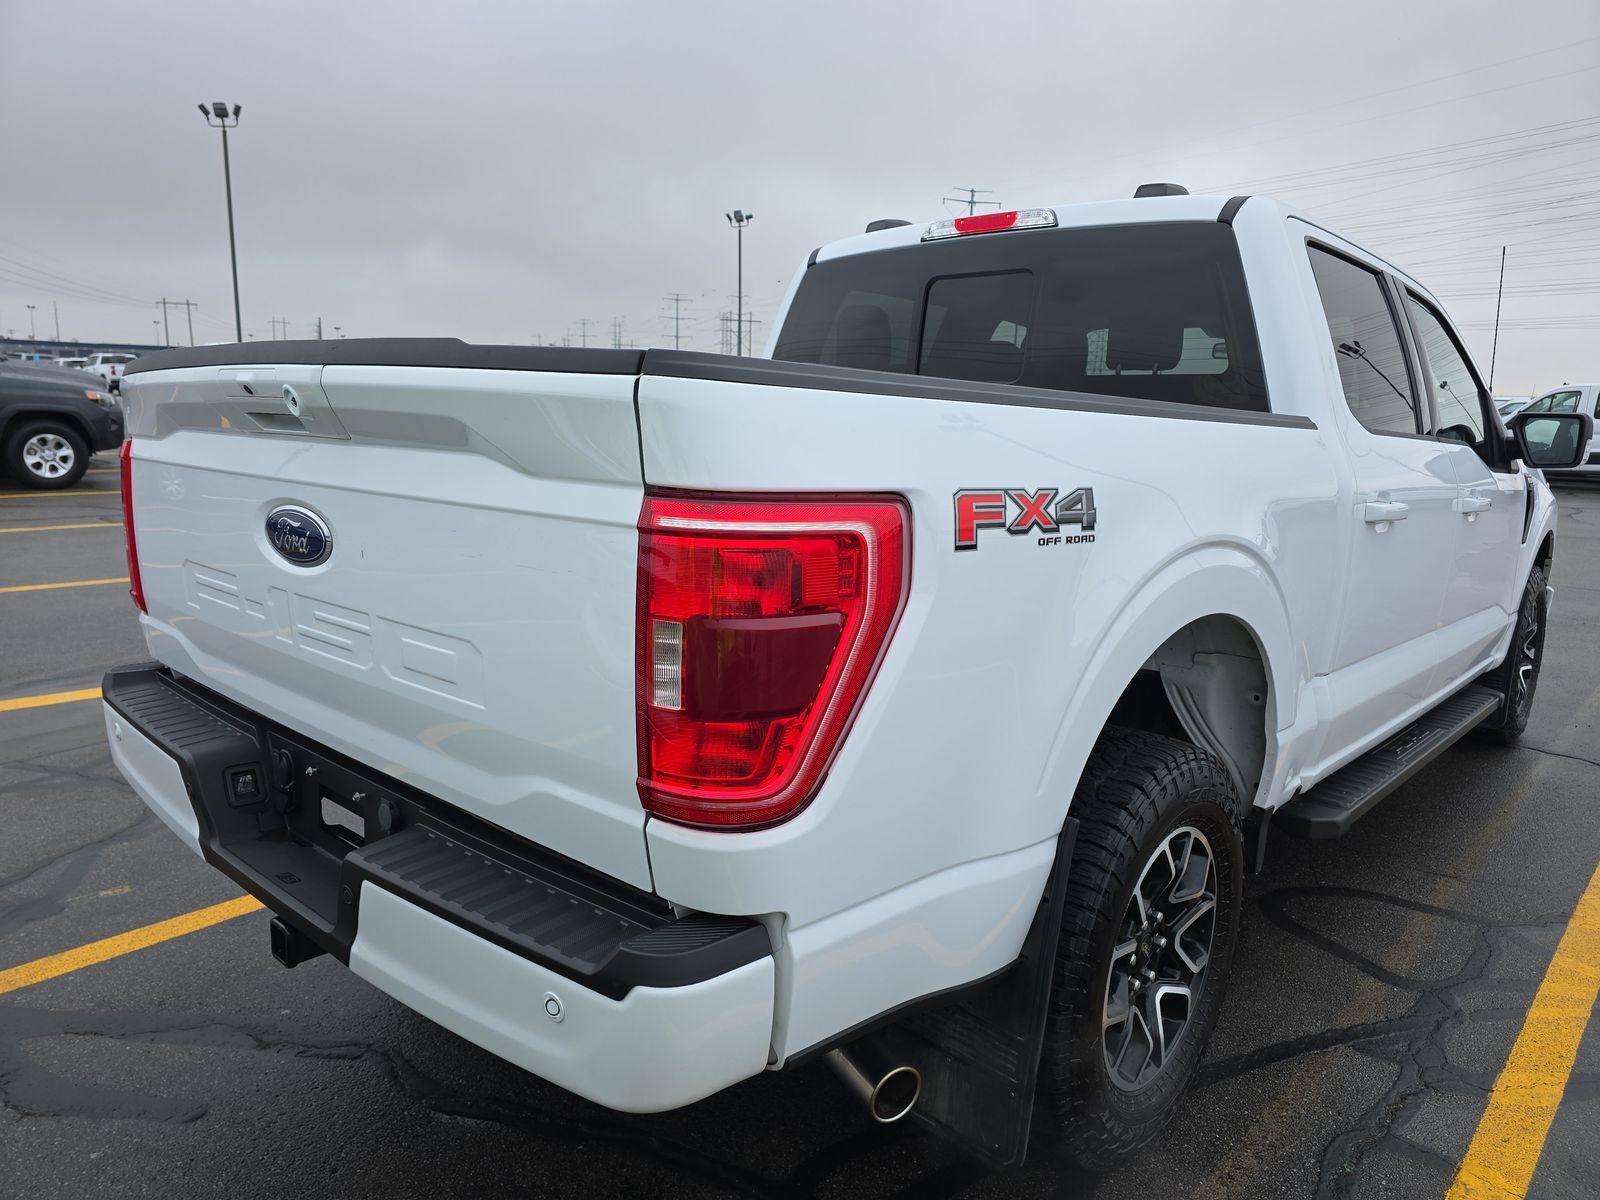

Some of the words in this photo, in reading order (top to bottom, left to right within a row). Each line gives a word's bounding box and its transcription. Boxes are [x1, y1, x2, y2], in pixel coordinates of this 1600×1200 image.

[275, 517, 310, 554] Ford
[953, 487, 1097, 551] FX4
[1038, 537, 1062, 547] OFF
[1066, 534, 1095, 545] ROAD
[182, 559, 486, 710] F-150
